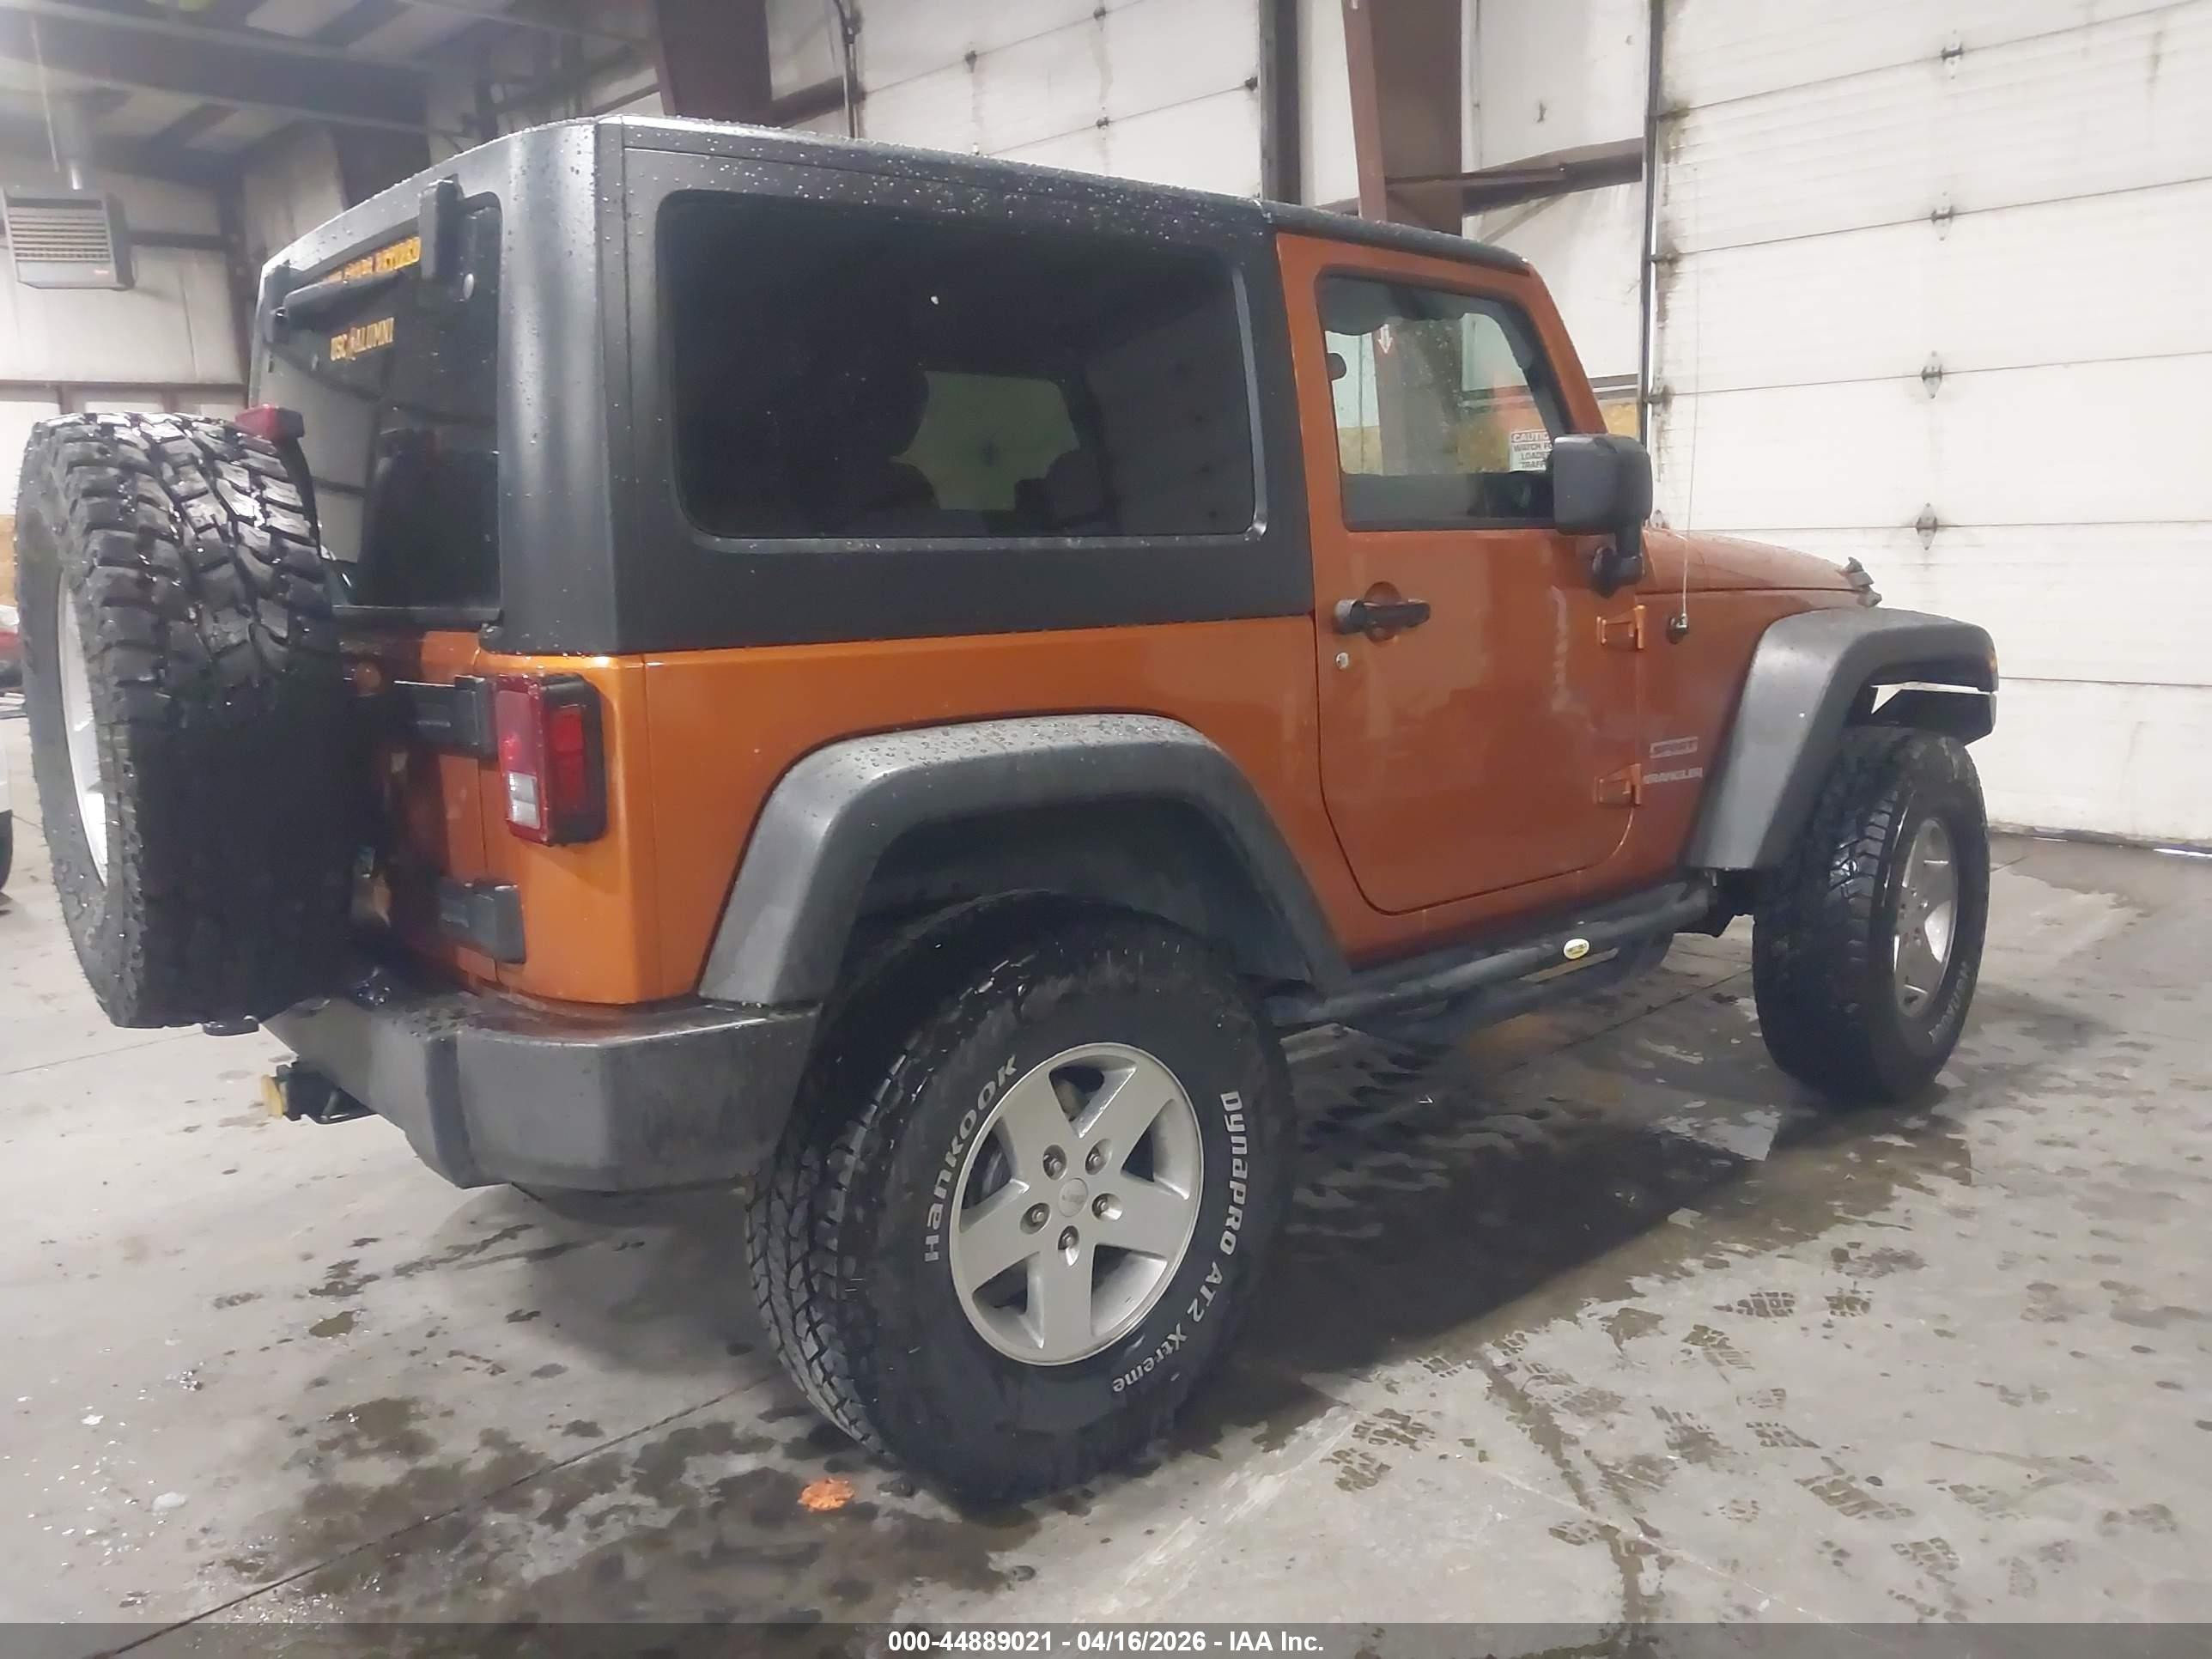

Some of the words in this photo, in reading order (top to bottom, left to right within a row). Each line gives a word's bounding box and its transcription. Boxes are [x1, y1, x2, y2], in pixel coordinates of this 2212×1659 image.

[1512, 431, 1550, 441] CAUTIO
[1187, 1261, 1223, 1322] AT2
[1113, 1323, 1188, 1392] Xtreme
